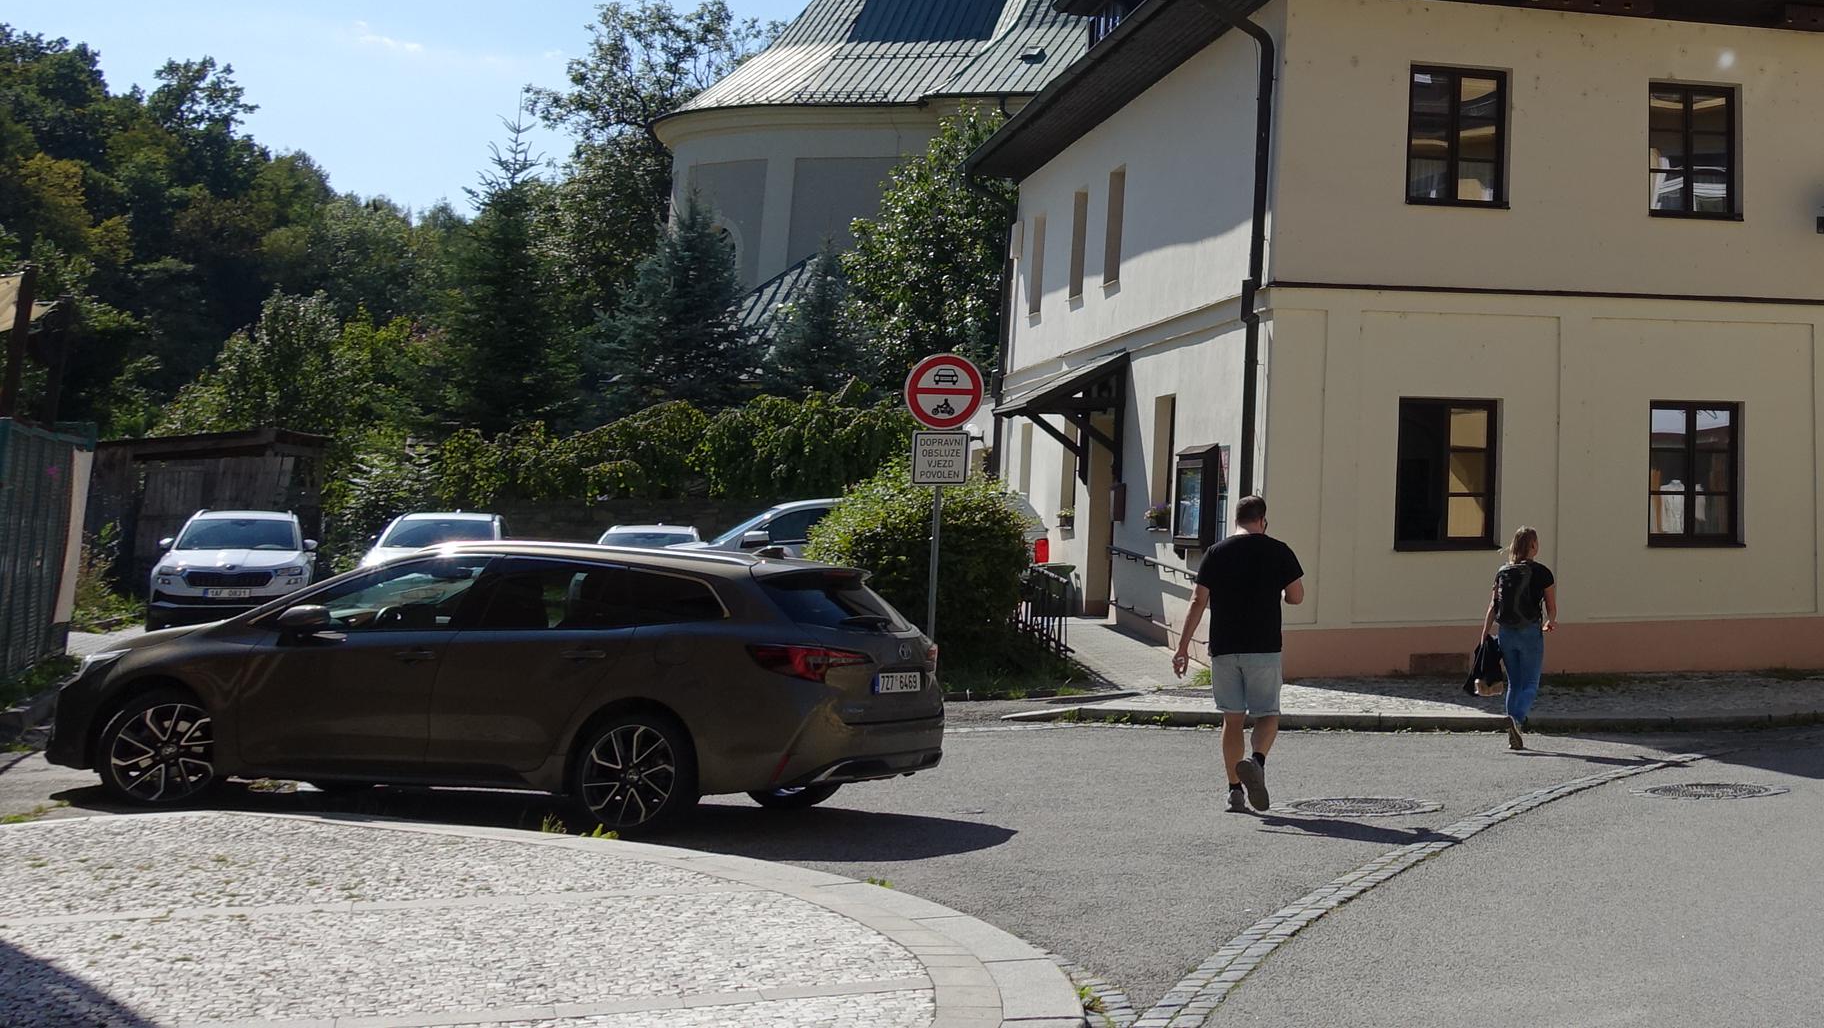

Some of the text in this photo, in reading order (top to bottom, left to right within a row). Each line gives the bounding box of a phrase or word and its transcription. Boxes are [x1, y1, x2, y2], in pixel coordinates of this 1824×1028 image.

[920, 438, 963, 447] DOPRAVNÍ
[921, 449, 960, 458] OBSLUZE
[927, 460, 953, 468] VJEZD
[920, 471, 960, 479] POVOLEN
[899, 674, 917, 690] 6469
